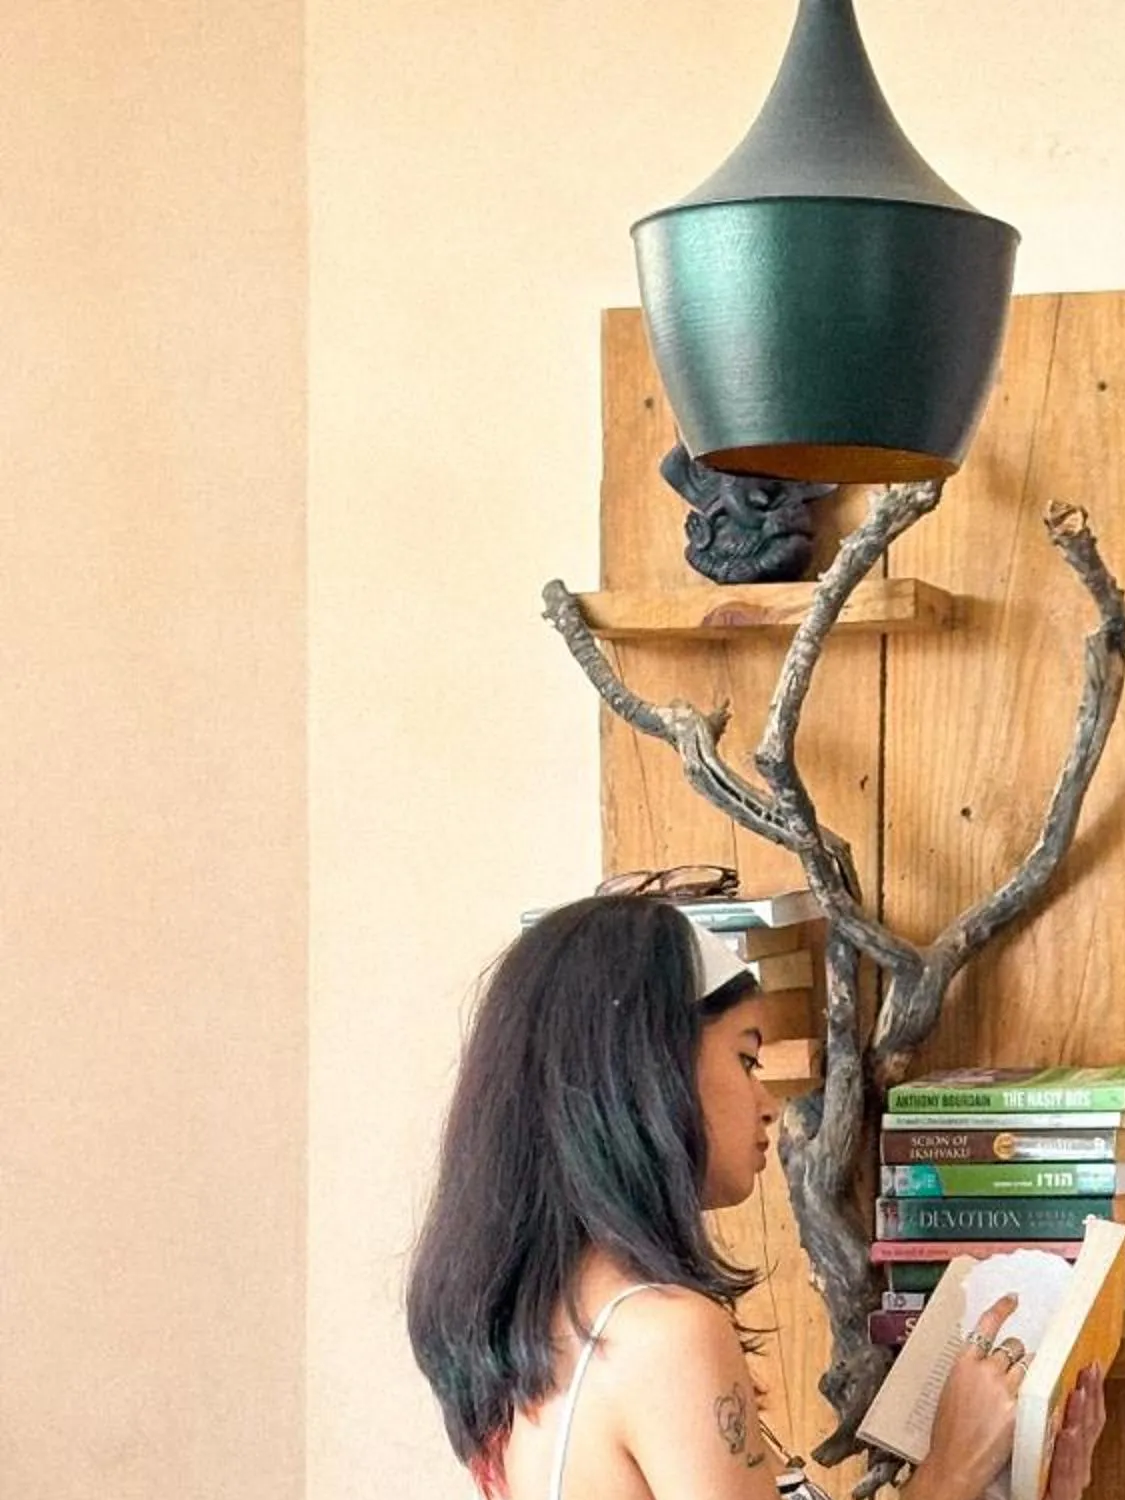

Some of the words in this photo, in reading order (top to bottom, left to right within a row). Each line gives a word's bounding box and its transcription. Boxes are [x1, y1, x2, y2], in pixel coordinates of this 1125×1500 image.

[1002, 1090, 1025, 1108] THE
[911, 1135, 949, 1147] SCION
[952, 1135, 968, 1147] OF
[909, 1147, 971, 1159] IKSHVAKU
[919, 1210, 1021, 1229] DEVOTION
